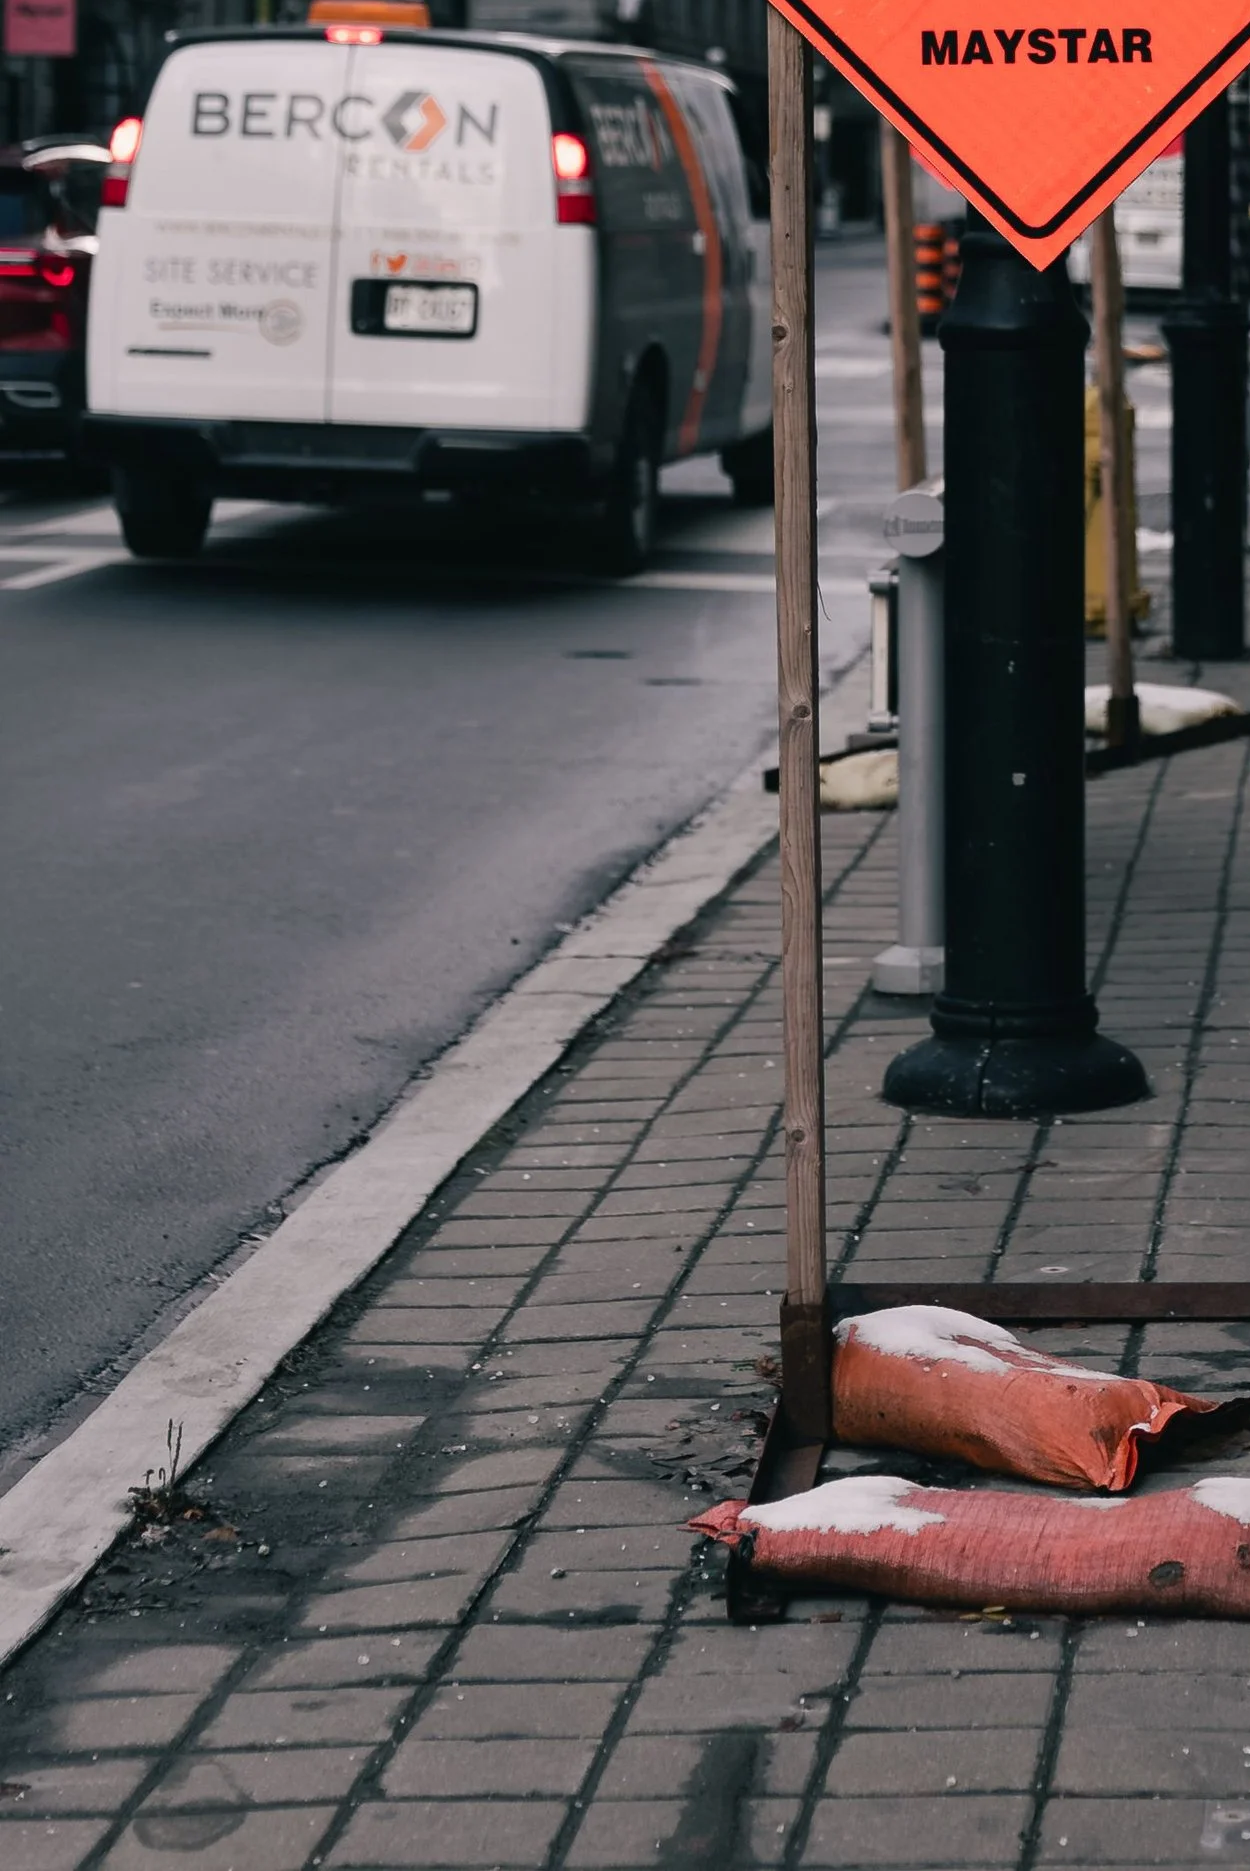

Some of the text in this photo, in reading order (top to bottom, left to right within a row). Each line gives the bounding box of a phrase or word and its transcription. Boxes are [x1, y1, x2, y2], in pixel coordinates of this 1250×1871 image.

[920, 28, 1153, 66] MAYSTAR
[345, 154, 496, 185] RENTALS
[144, 256, 318, 289] SITE SERVICE
